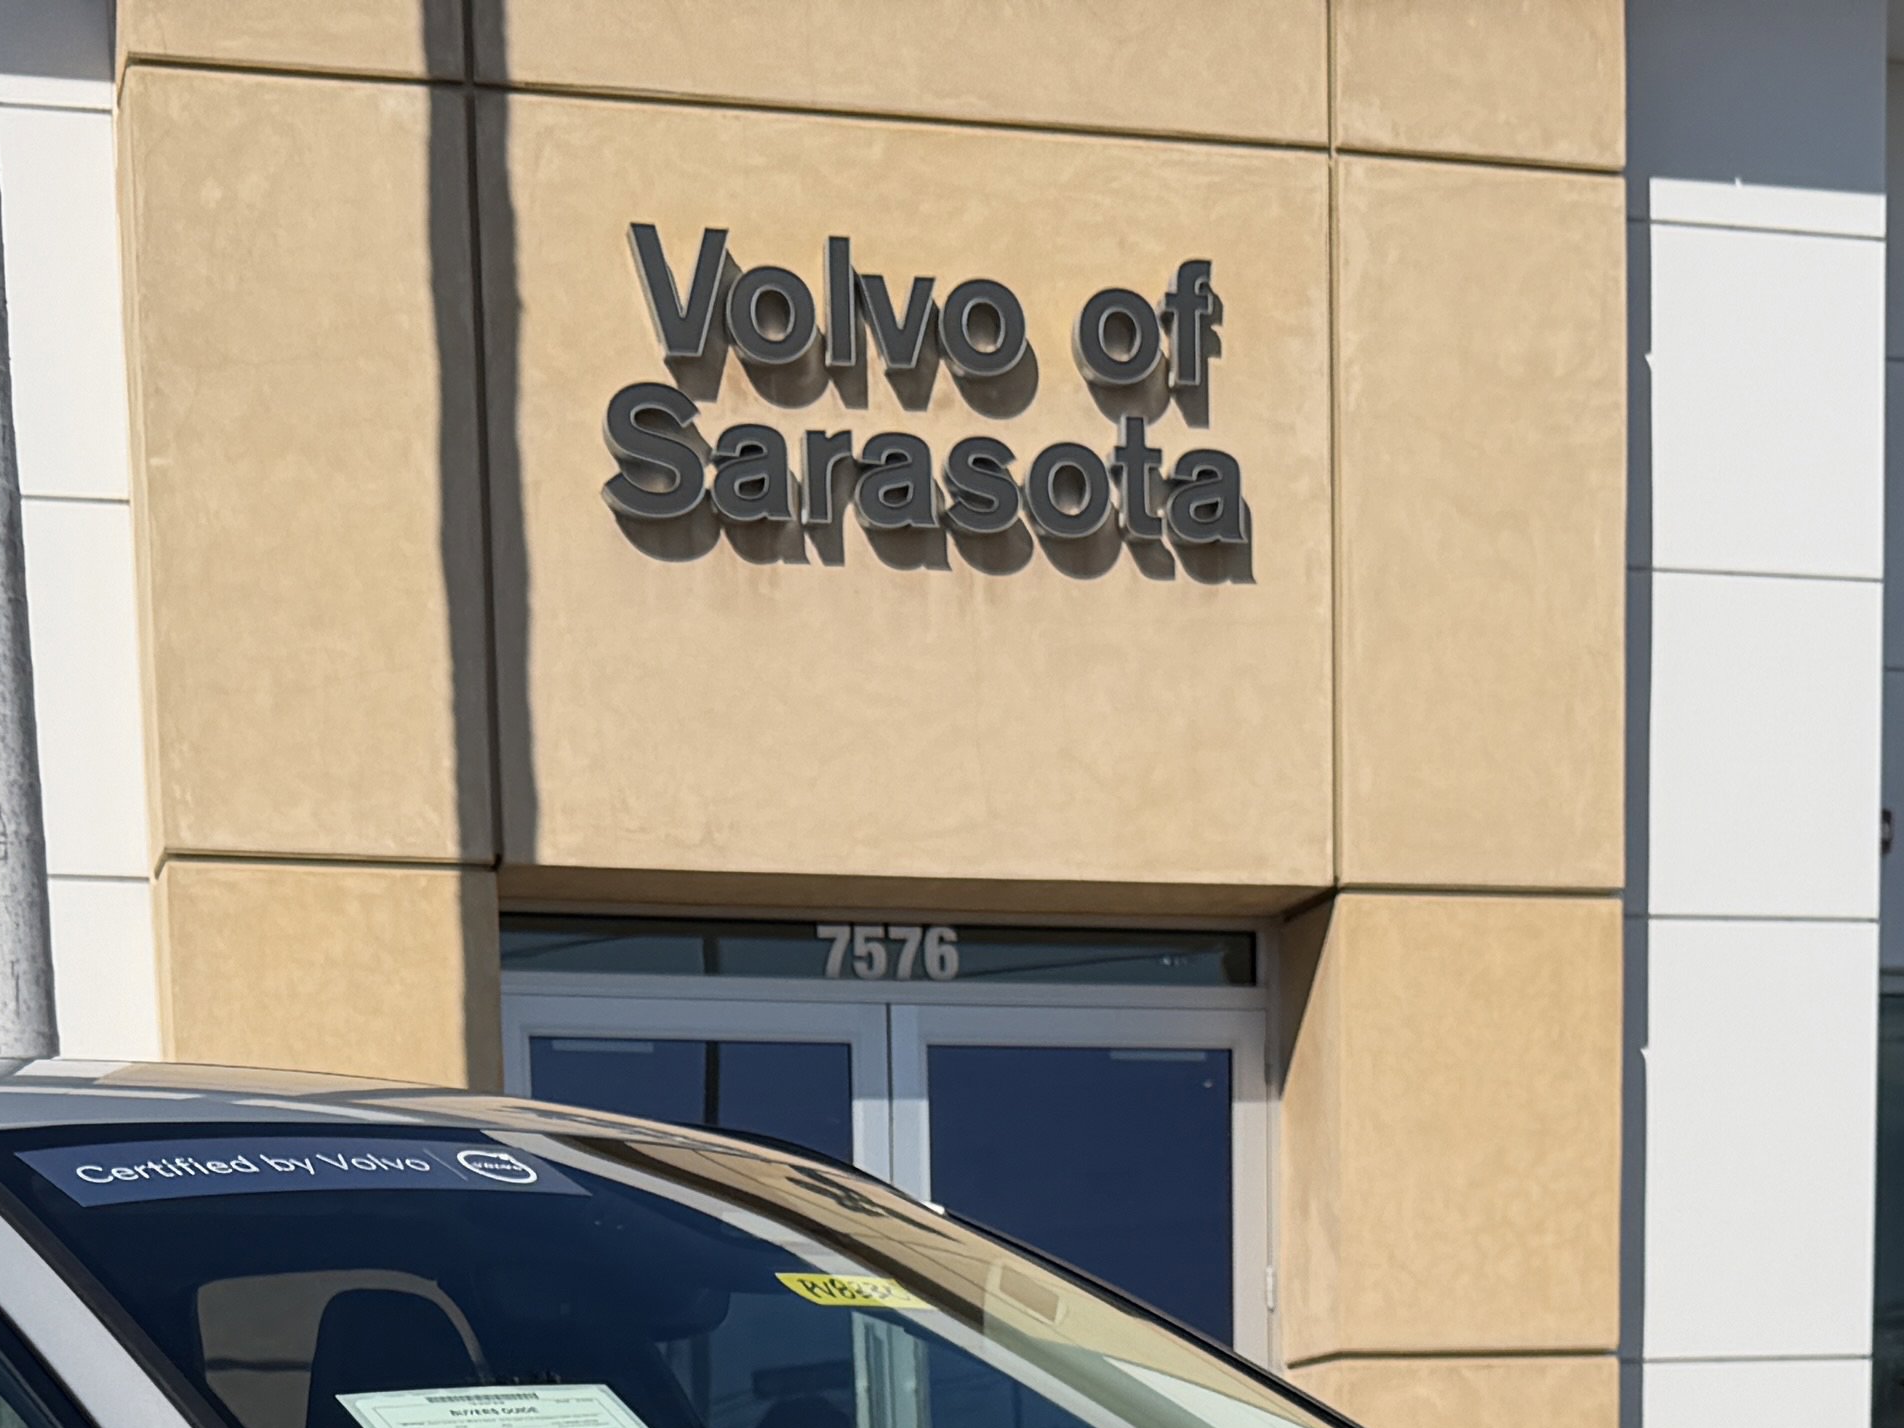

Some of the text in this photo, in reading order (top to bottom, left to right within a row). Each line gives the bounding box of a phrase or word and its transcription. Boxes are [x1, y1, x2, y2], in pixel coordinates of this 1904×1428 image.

[628, 222, 1213, 387] Volvo of
[601, 380, 1248, 544] Sarasota
[816, 924, 960, 980] 7576
[75, 1152, 430, 1185] Certified by Volvo
